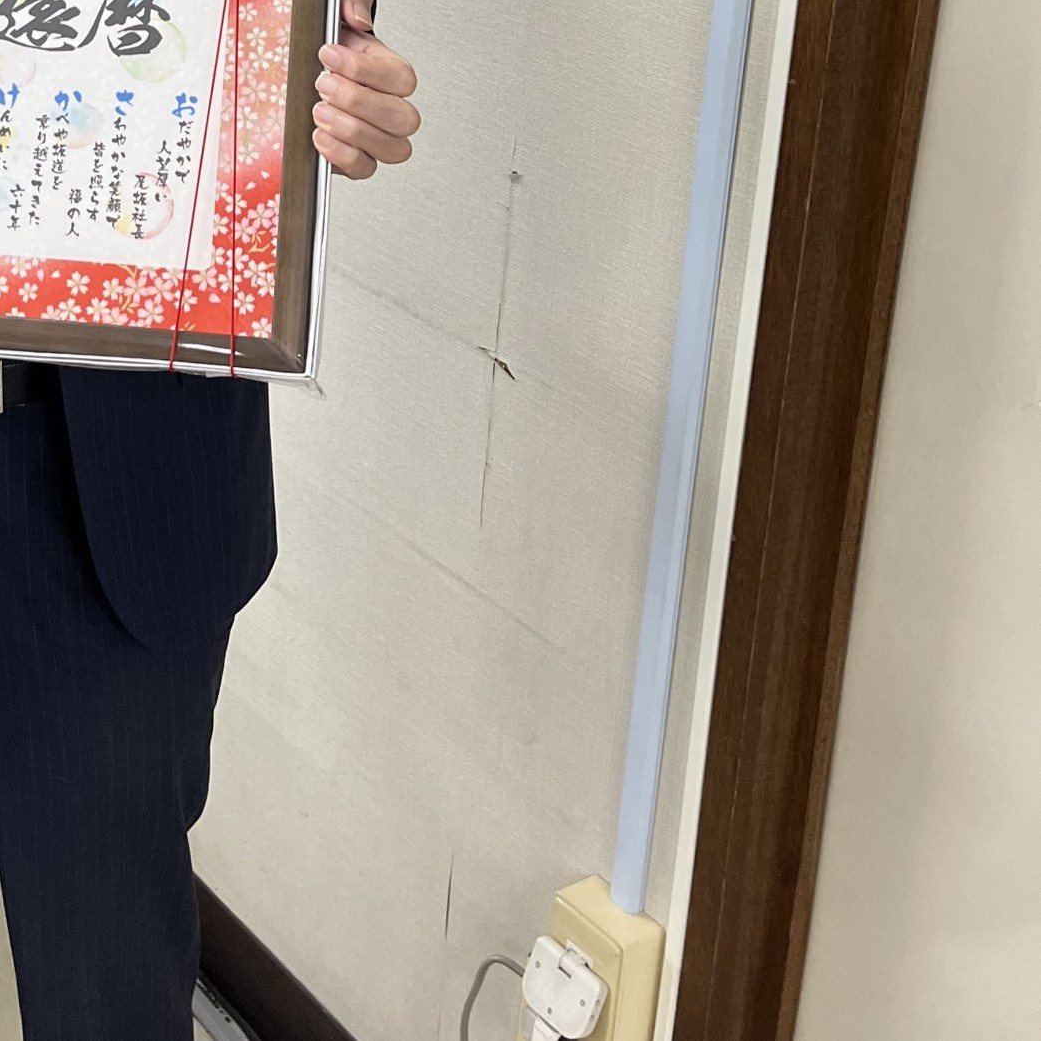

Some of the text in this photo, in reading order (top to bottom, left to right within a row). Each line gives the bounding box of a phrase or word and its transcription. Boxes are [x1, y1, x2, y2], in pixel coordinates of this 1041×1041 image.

[28, 114, 50, 226] 乗り越えてきた
[51, 90, 82, 190] かべや坂道を
[106, 90, 134, 229] さわやかな笑顔で
[155, 140, 171, 202] 人望厚い
[172, 92, 198, 183] おだやかで
[7, 184, 25, 231] 六十年
[65, 188, 82, 237] 福の人
[86, 141, 106, 221] 皆を照らす
[131, 174, 149, 240] 尾坂社長
